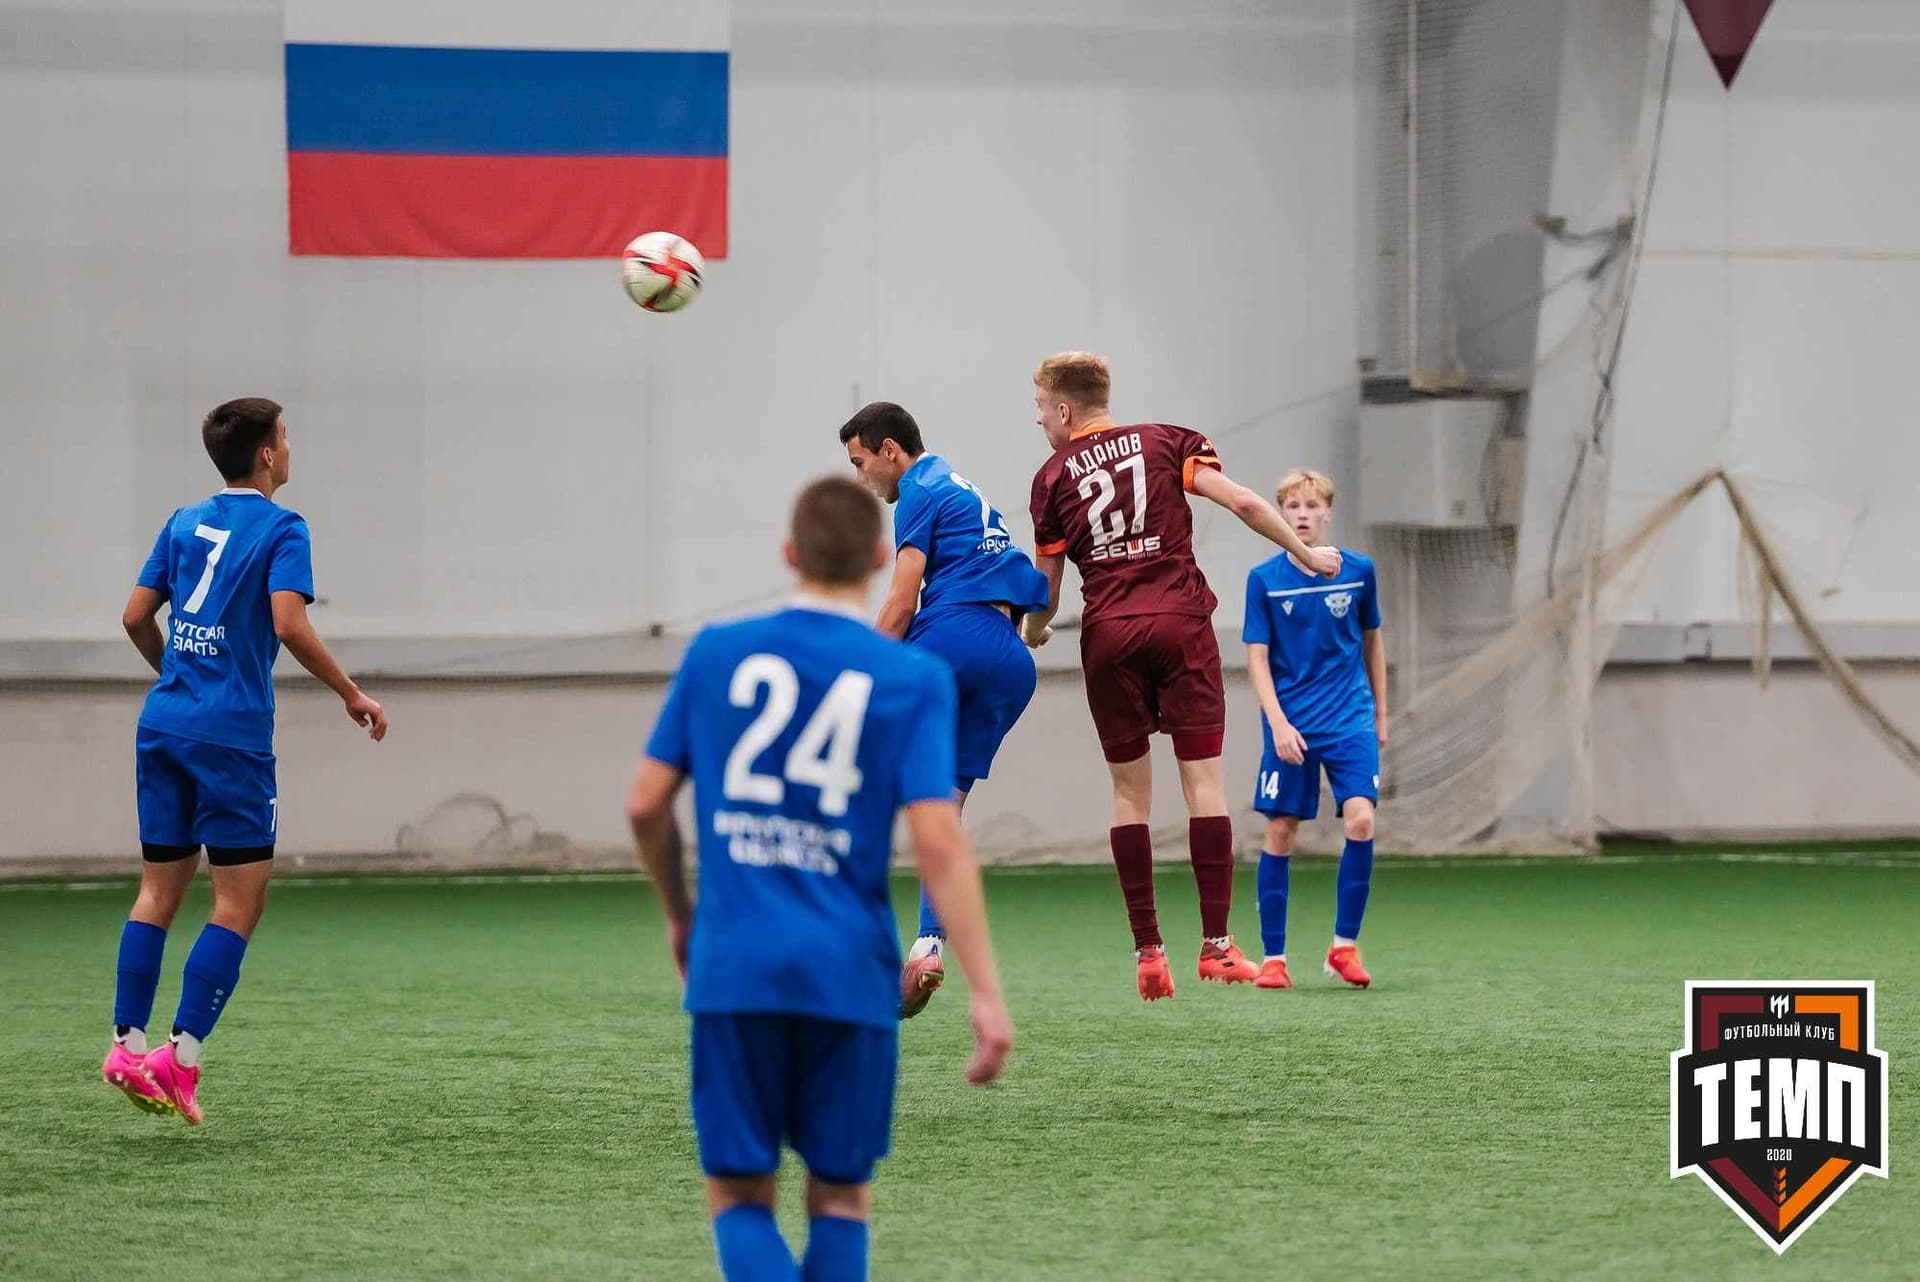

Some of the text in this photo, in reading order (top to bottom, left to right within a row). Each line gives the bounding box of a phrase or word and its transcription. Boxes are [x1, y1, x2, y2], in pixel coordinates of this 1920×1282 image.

[1065, 433, 1142, 479] ЖДАНОВ
[950, 472, 1010, 538] 2
[1078, 454, 1147, 546] 27
[183, 524, 231, 614] 7
[724, 652, 874, 817] 24
[1261, 770, 1279, 800] 14
